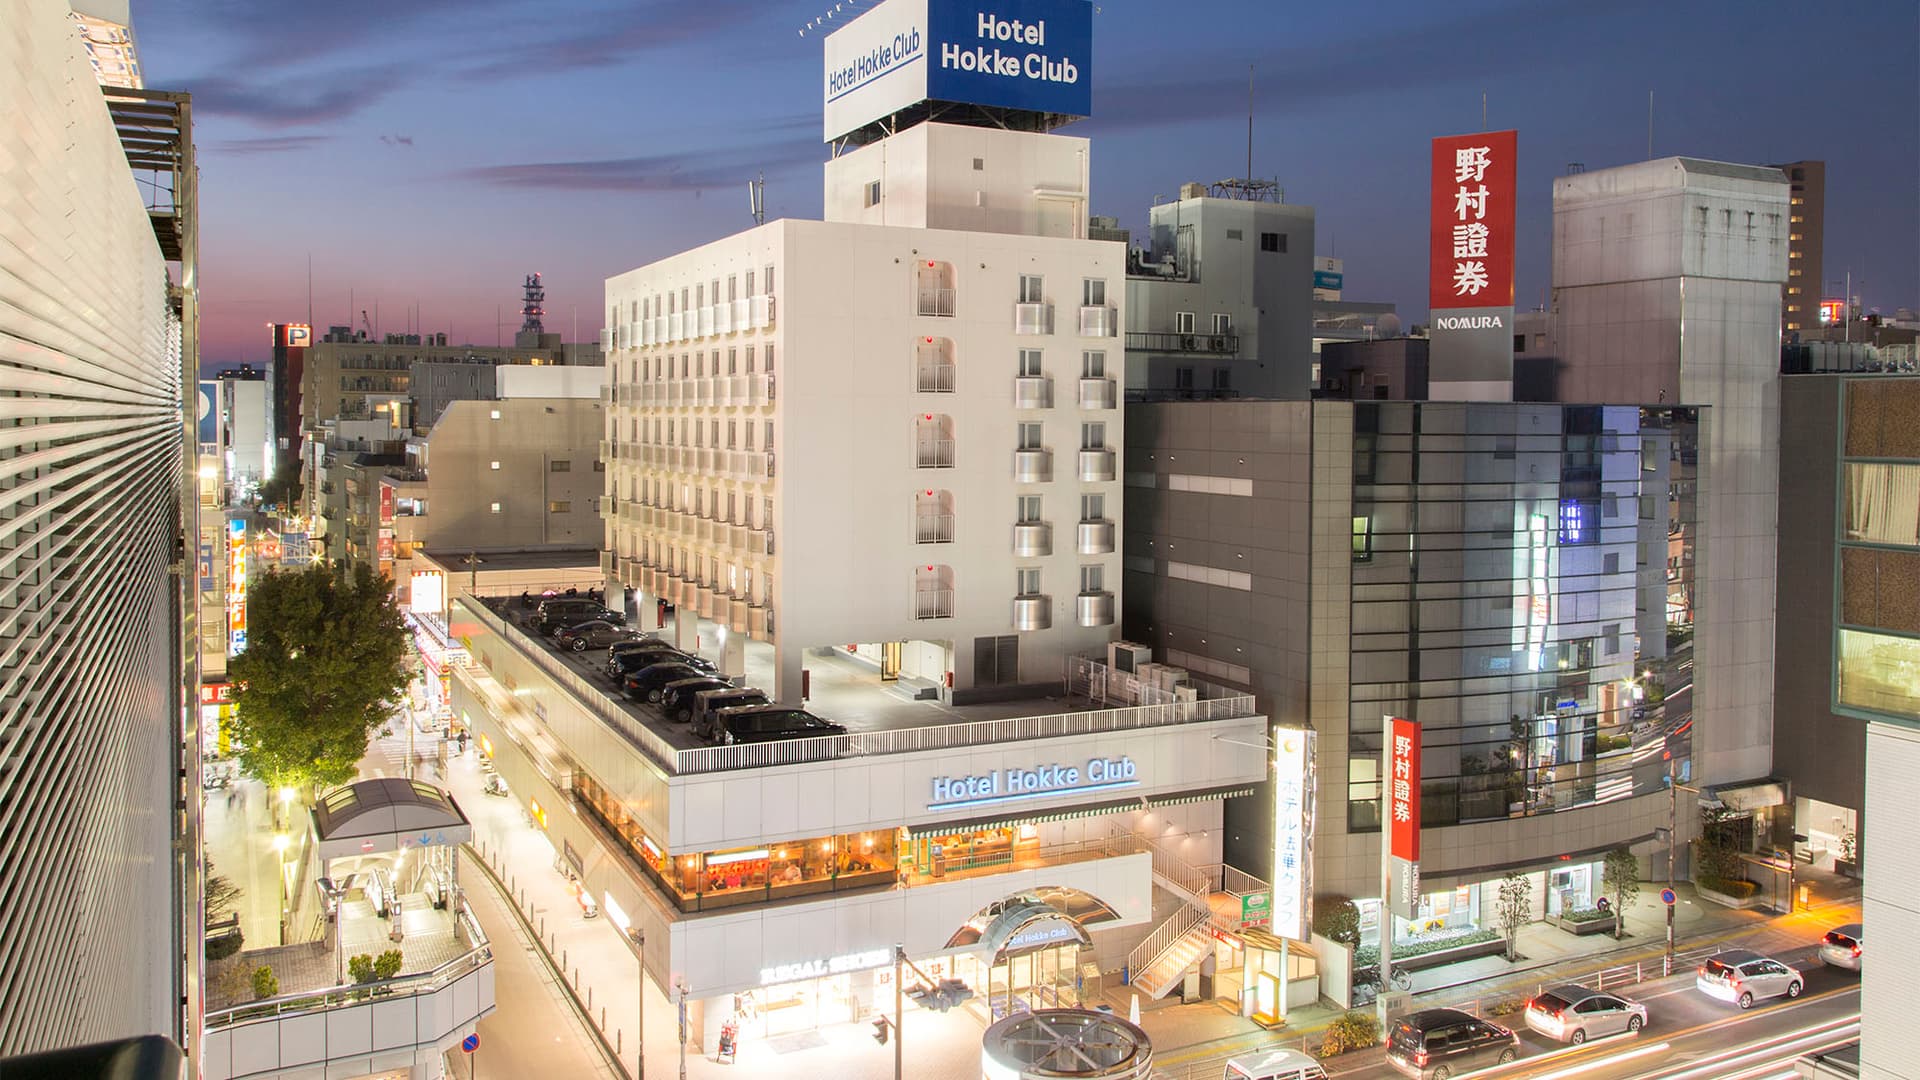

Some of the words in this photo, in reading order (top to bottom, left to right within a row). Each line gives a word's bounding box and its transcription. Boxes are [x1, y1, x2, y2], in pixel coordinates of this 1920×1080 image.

[976, 12, 1045, 46] Hotel
[829, 60, 857, 95] Hotel
[857, 45, 892, 79] Hokke
[893, 27, 921, 61] Club
[941, 43, 1021, 77] Hokke
[1023, 53, 1079, 84] Club
[1453, 146, 1492, 296] 野村證券
[289, 328, 307, 345] P
[1437, 316, 1503, 330] NOMURA
[932, 769, 999, 801] Hotel
[1006, 763, 1080, 794] Hokke
[1087, 755, 1137, 783] Club
[1394, 735, 1411, 823] 野村證券
[1402, 863, 1410, 904] NOMURA
[1411, 865, 1419, 905] NOMURA
[1025, 931, 1049, 943] Hokke
[1050, 927, 1068, 938] Club
[759, 959, 829, 986] REGAL
